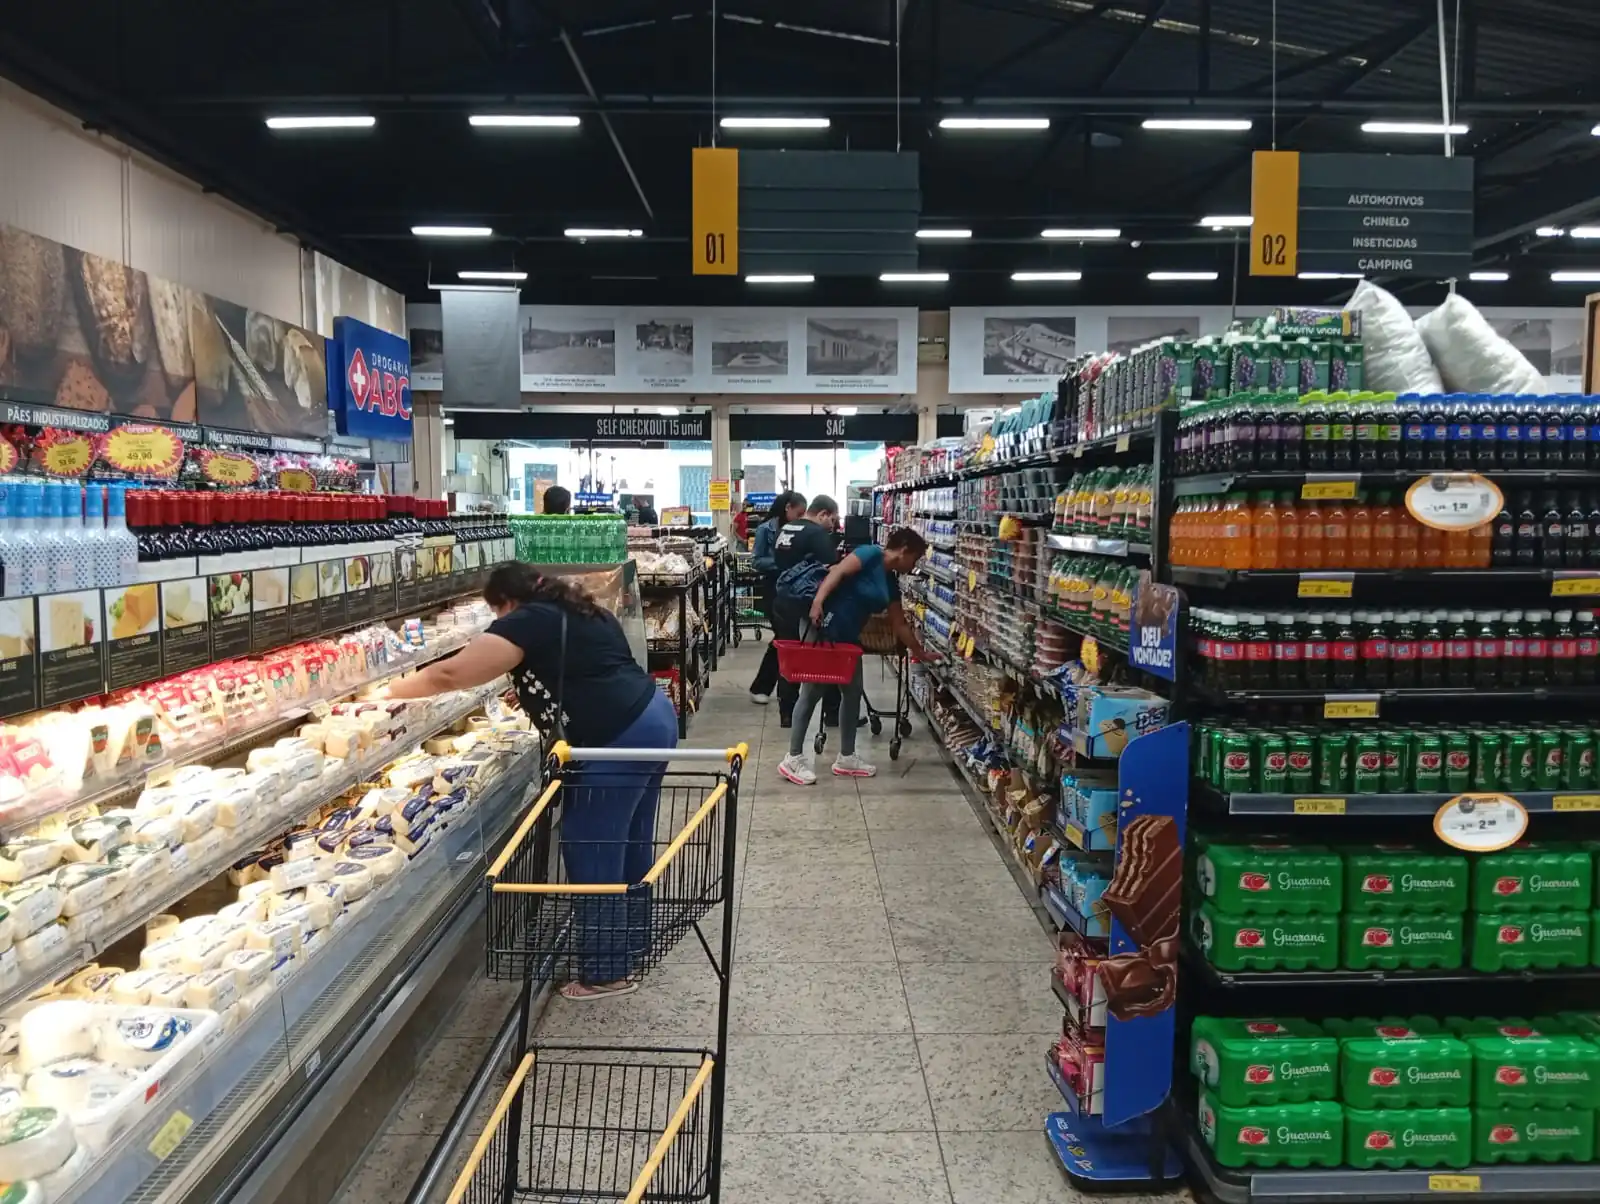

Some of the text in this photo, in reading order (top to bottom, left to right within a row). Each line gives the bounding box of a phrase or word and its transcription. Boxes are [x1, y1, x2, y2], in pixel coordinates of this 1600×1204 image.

[1348, 194, 1424, 206] AUTOMOTIVOS
[1363, 216, 1410, 227] CHINELO
[705, 232, 725, 265] 01
[1262, 234, 1287, 266] 02
[1352, 237, 1418, 248] INSETICIDAS
[1358, 259, 1413, 270] CAMPING
[371, 353, 409, 376] DROGARIA
[368, 368, 412, 420] ABC
[7, 406, 109, 431] PÃES INDUSTRIALIZADOS
[597, 418, 703, 436] SELF CHECKOUT 15 unid
[826, 419, 845, 436] SAC
[1142, 626, 1161, 648] DEU
[1133, 646, 1173, 668] VONTADE?
[1277, 872, 1331, 890] Guaraná
[1401, 874, 1455, 892] Guaraná
[1529, 875, 1580, 892] Guaraná
[1272, 928, 1327, 946] Guaraná
[1400, 926, 1454, 944] Guaraná
[1530, 924, 1582, 942] Guaraná
[1280, 1061, 1331, 1080] Guaraná
[1407, 1066, 1461, 1084] Guaraná
[1533, 1065, 1590, 1084] Guaraná
[1276, 1126, 1332, 1145] Guaraná
[1402, 1128, 1457, 1147] Guaraná
[1525, 1122, 1581, 1141] Guaraná
